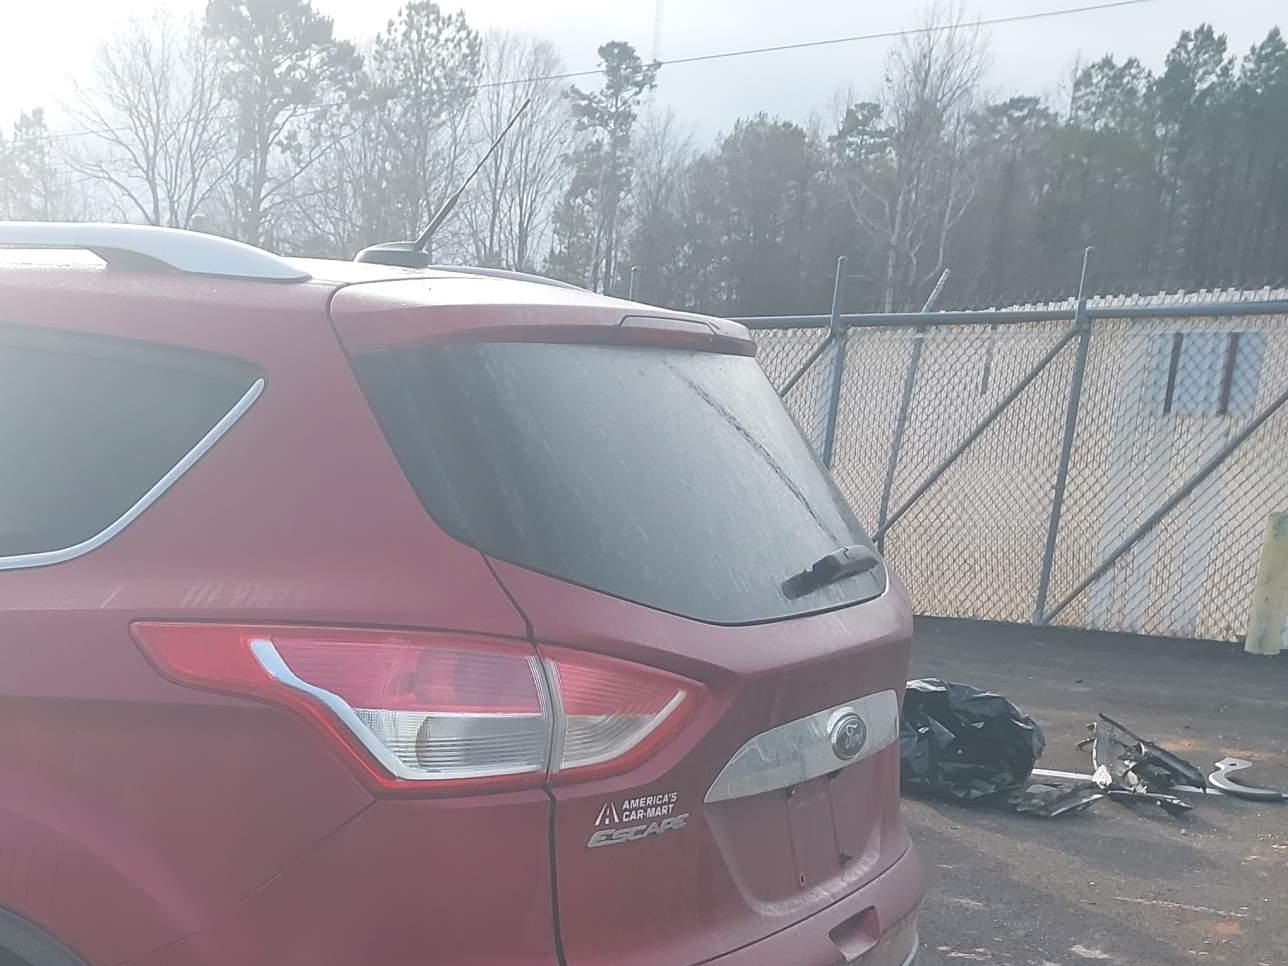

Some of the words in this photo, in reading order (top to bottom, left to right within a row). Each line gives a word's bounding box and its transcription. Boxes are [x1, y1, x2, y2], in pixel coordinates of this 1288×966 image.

[622, 792, 677, 809] AMERICA'S
[622, 804, 674, 822] CAR-MART
[587, 813, 689, 848] ESCAPE
